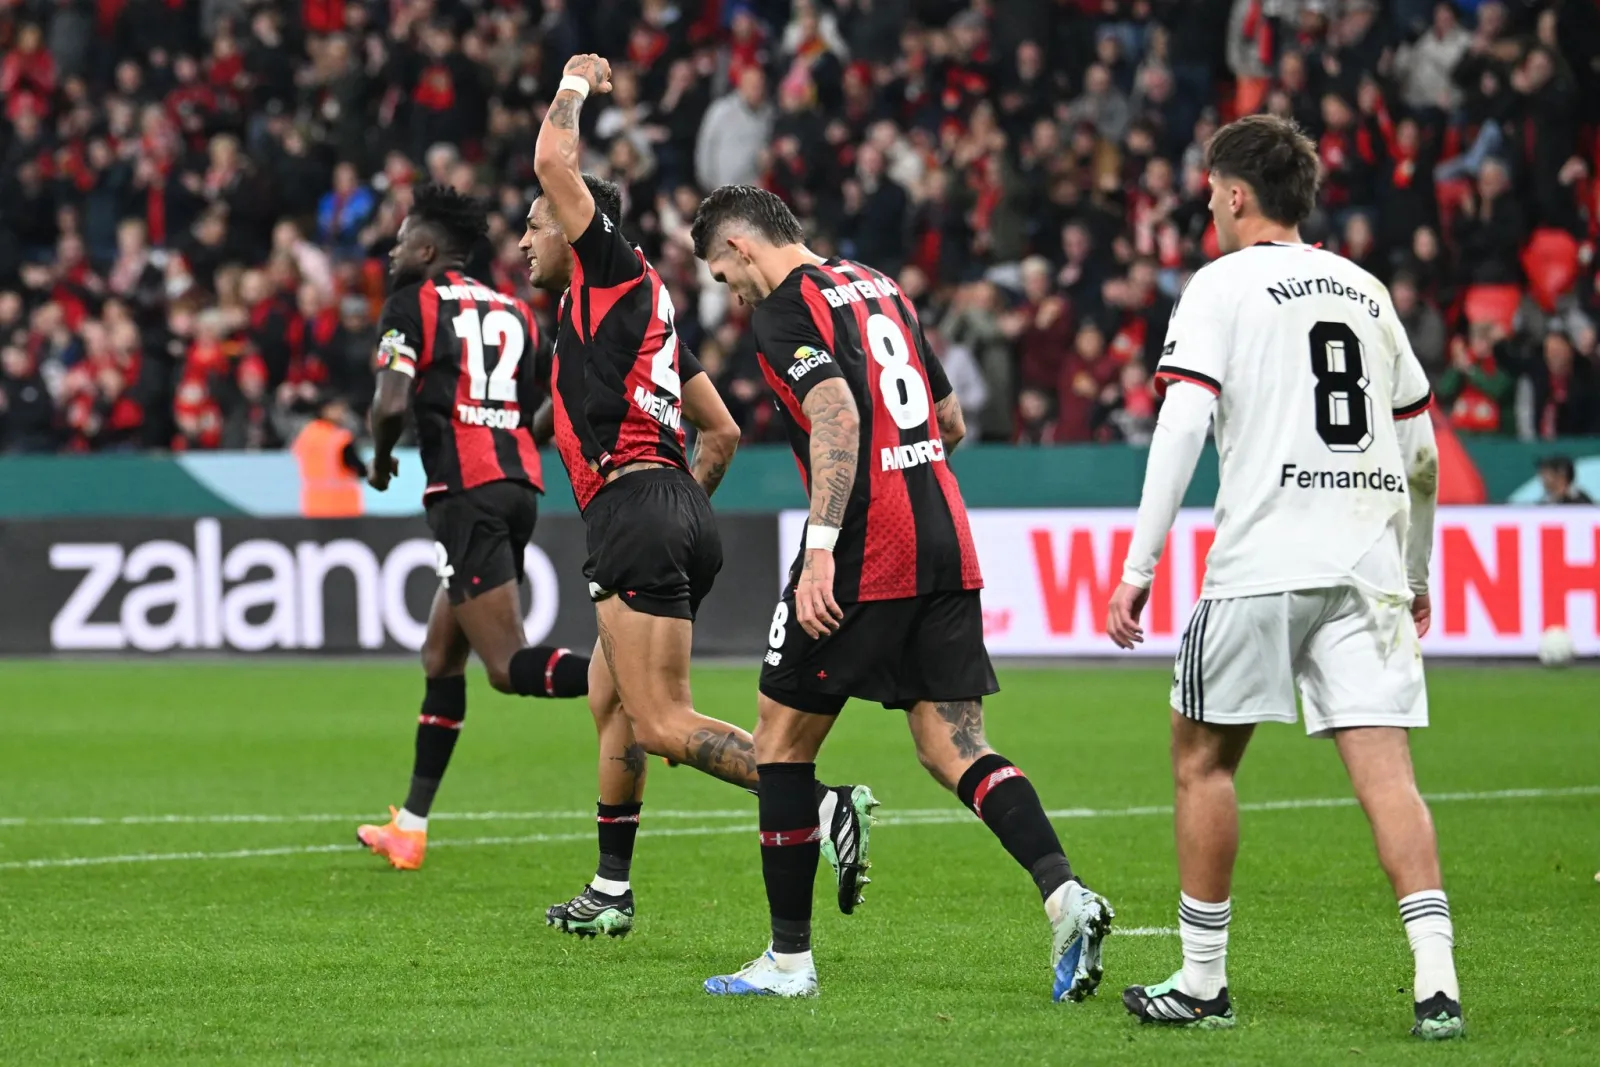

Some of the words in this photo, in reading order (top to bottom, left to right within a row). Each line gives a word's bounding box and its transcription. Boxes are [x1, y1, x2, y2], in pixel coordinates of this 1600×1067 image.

[1266, 276, 1380, 318] Nürnberg
[452, 307, 525, 402] 12
[787, 350, 832, 382] Talcid
[866, 313, 930, 430] 8
[1308, 321, 1375, 453] 8
[1280, 463, 1405, 493] Fernandez
[768, 601, 789, 649] 8
